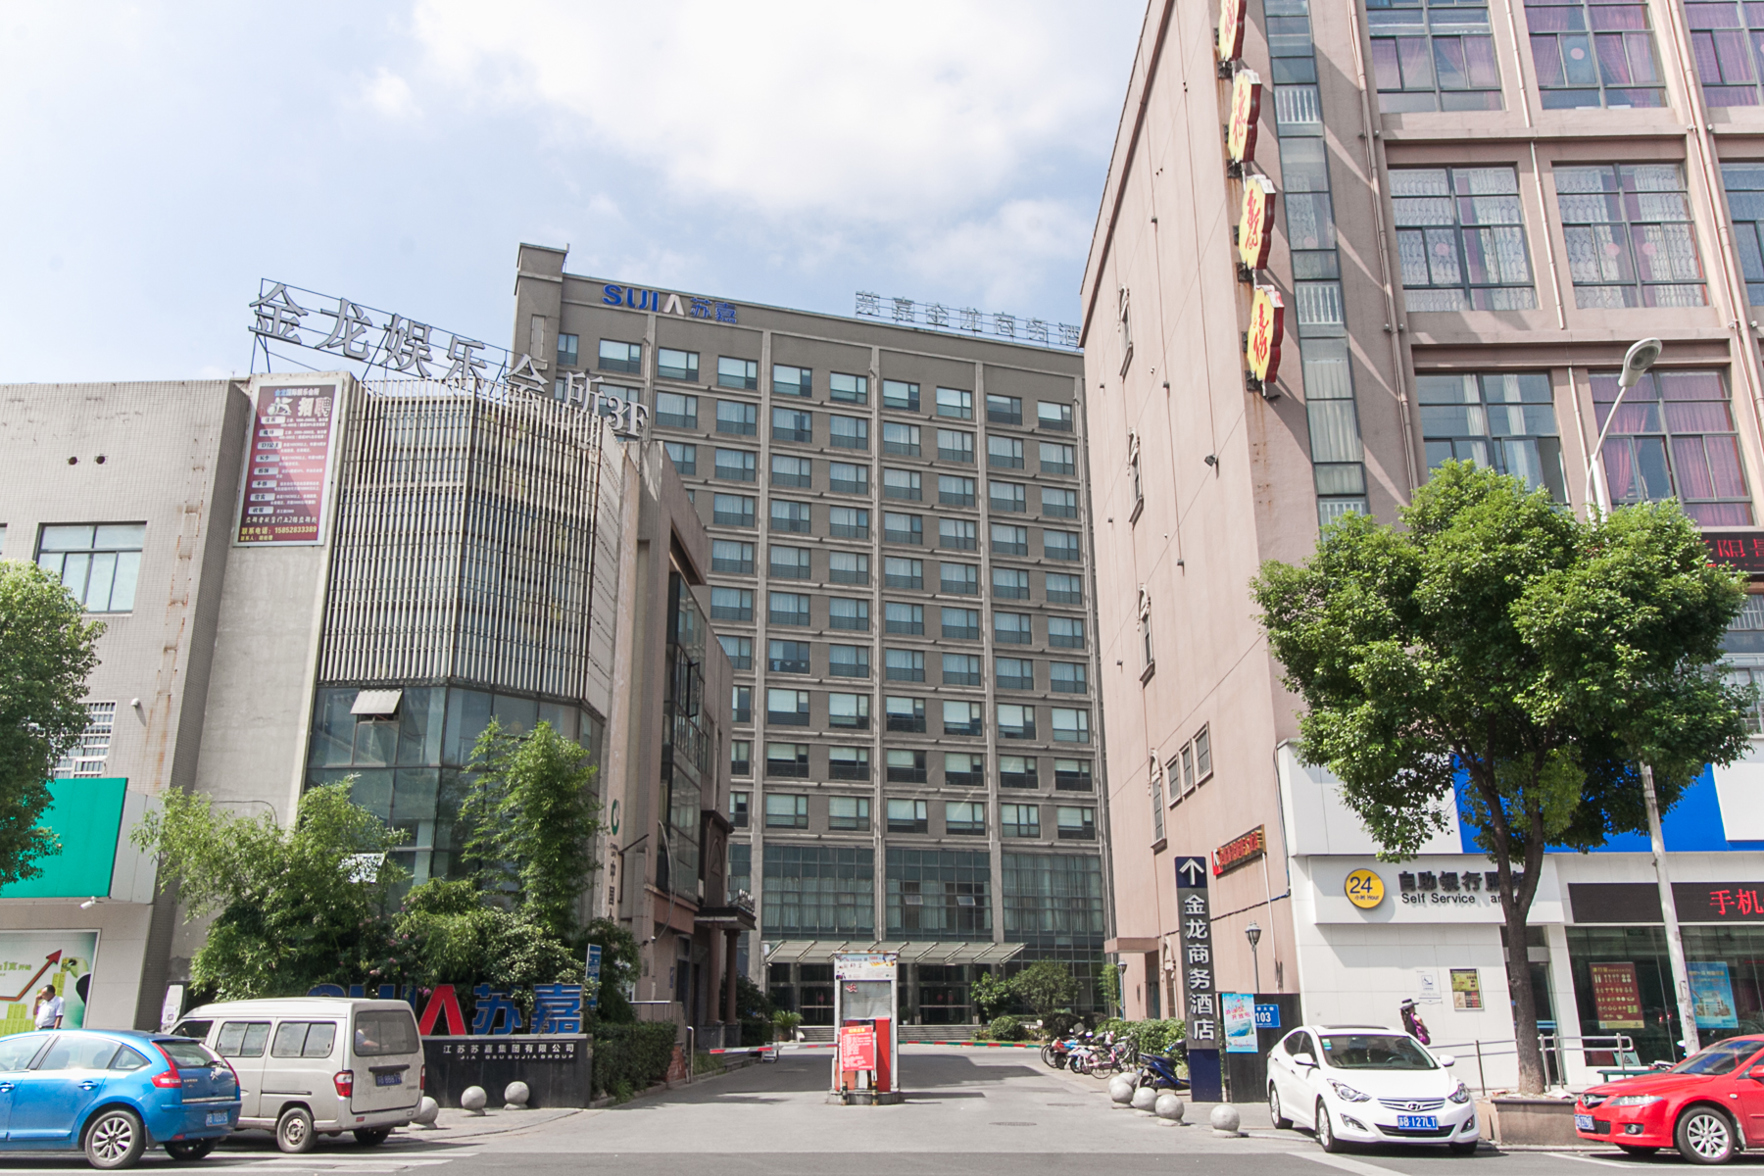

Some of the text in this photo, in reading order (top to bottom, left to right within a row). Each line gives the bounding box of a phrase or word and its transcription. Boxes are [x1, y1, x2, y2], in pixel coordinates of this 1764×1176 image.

[297, 396, 332, 417] 招聘
[1350, 876, 1373, 894] 24
[1401, 892, 1426, 904] Self
[1431, 892, 1476, 904] Service
[1184, 894, 1215, 1041] 金龙商务酒店
[472, 982, 583, 1035] 苏嘉
[1255, 1011, 1272, 1023] 103
[443, 1043, 575, 1054] 江苏苏嘉集团有限公司
